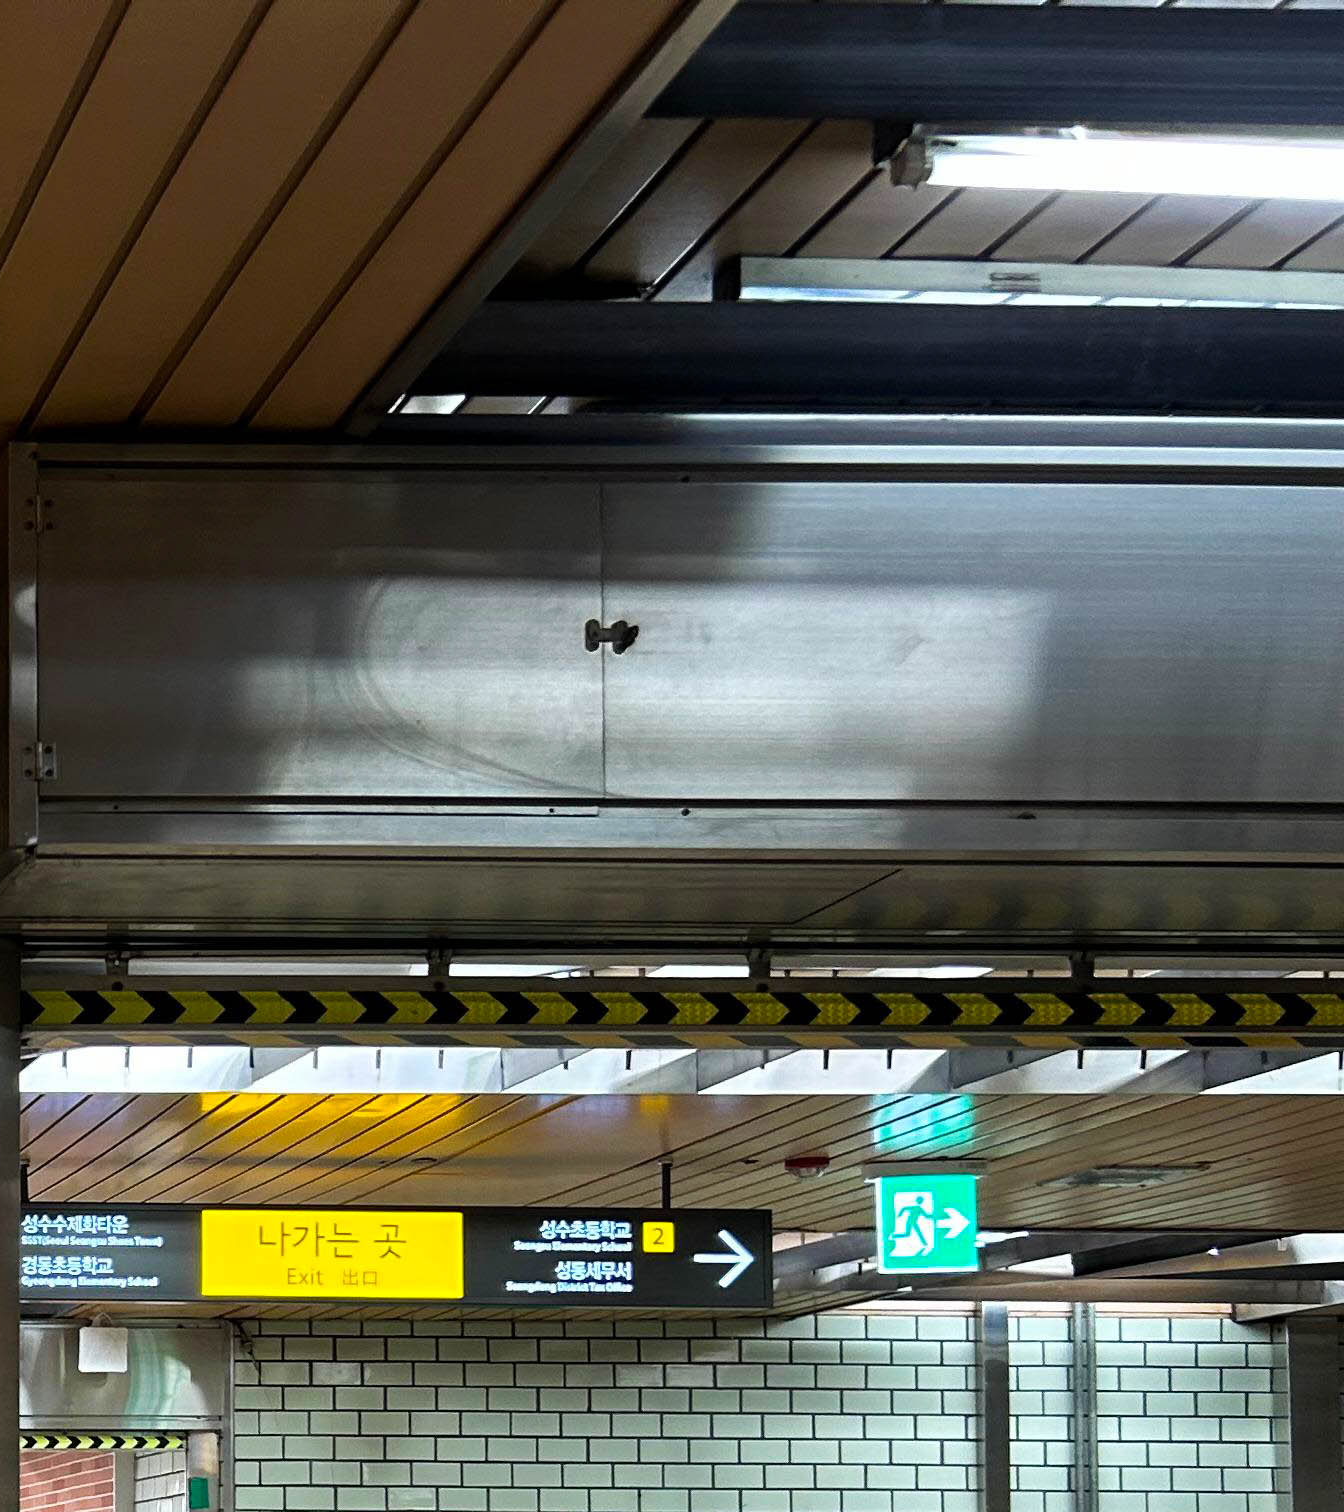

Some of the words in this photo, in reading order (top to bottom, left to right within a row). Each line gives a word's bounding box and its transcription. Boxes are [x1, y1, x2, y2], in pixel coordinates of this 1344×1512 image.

[21, 1214, 129, 1235] 성수수제화타운
[539, 1220, 632, 1239] 성수초등학교
[259, 1222, 360, 1259] 나가는
[374, 1224, 407, 1259] 곳
[652, 1228, 665, 1245] 2
[21, 1256, 114, 1276] 경동초등학교
[555, 1261, 632, 1280] 성동세무서
[287, 1268, 324, 1286] Exit
[342, 1269, 378, 1287] 出口
